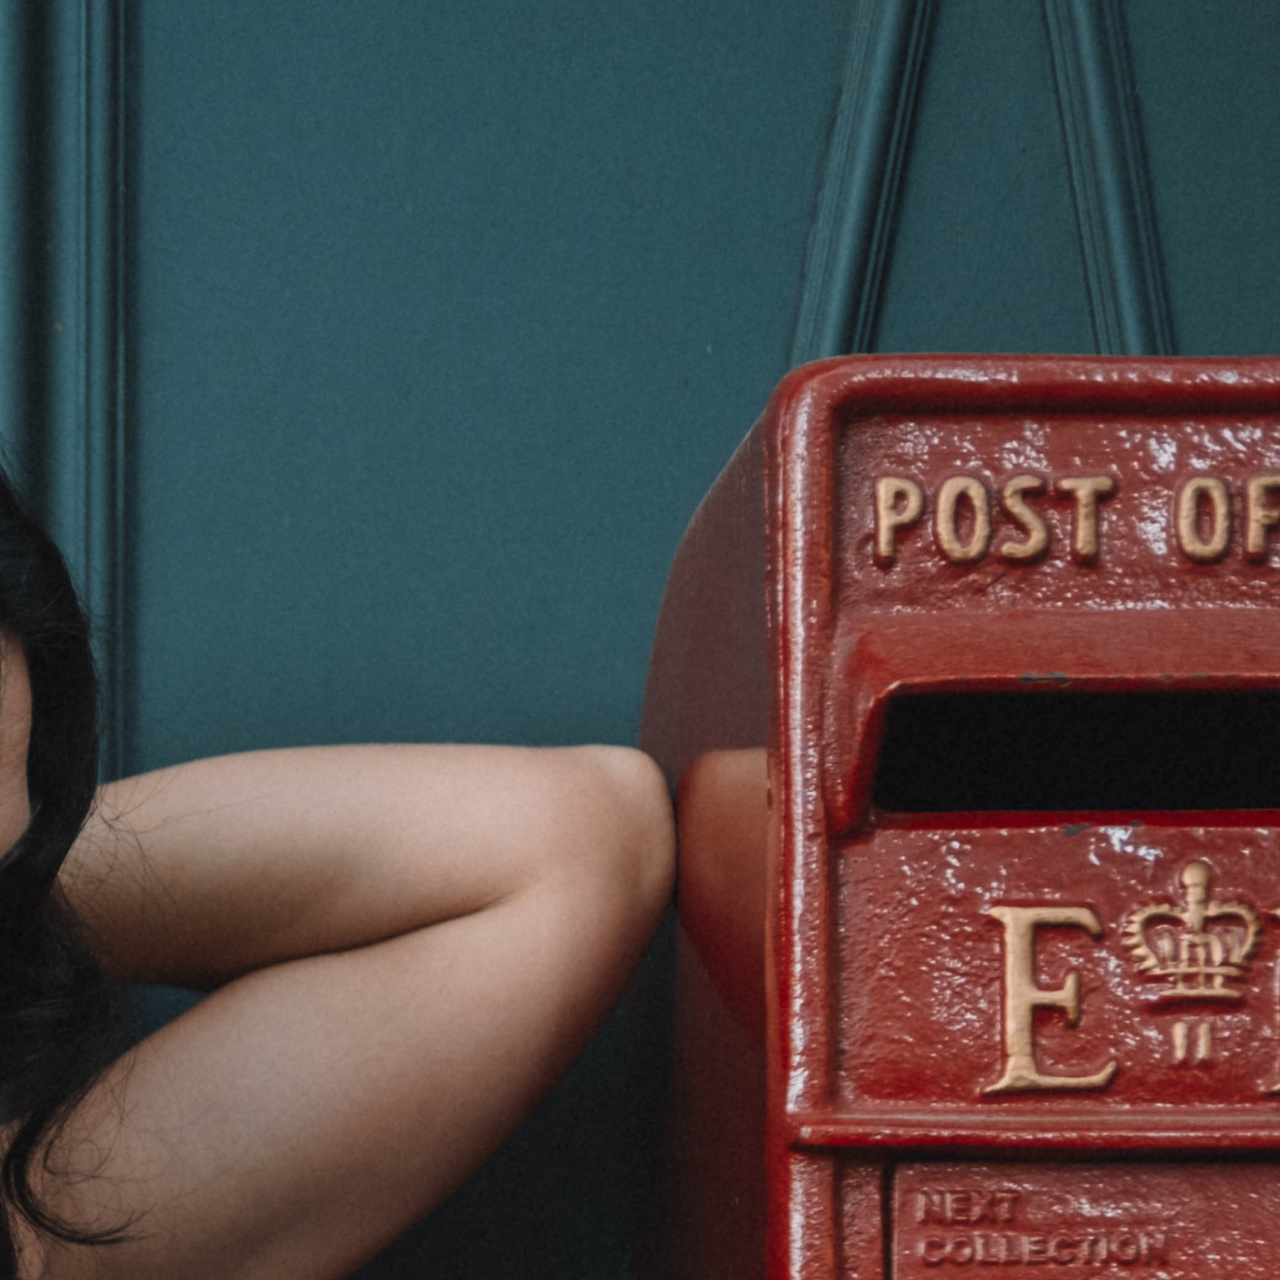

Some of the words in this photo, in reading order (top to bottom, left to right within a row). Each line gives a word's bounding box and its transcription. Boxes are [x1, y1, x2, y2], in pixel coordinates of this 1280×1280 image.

[875, 474, 1115, 560] POST
[1177, 474, 1280, 560] OF
[982, 905, 1117, 1094] E
[915, 1188, 1020, 1223] NEXT
[916, 1231, 1169, 1266] COLLECTION
